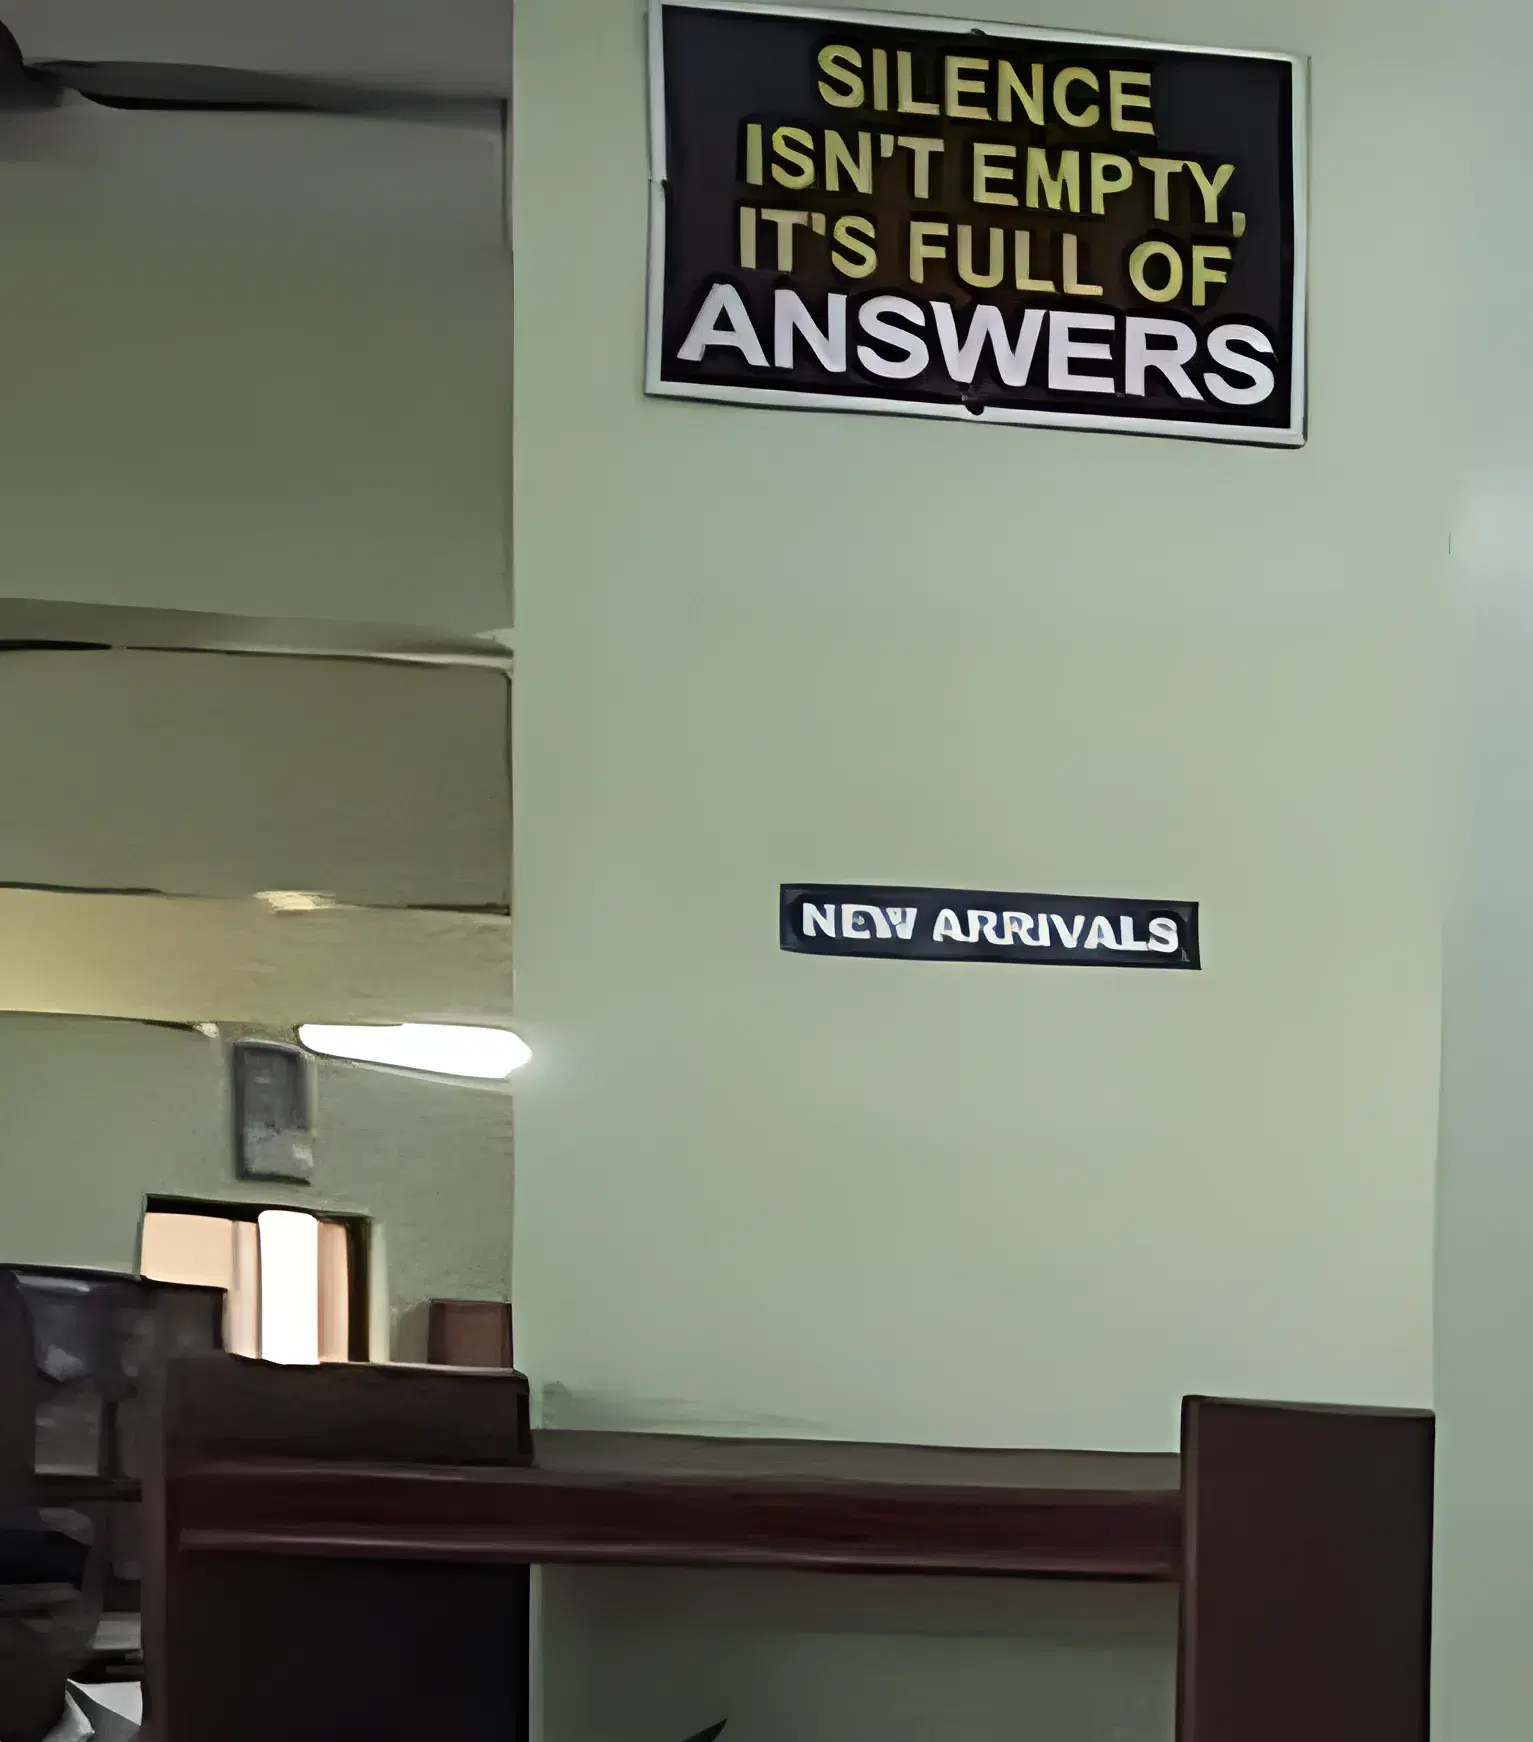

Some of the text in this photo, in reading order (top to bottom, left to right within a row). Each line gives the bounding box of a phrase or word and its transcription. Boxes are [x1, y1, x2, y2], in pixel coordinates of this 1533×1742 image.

[817, 44, 1155, 135] SILENCE
[745, 122, 1246, 237] ISN'T EMPTY,
[739, 207, 1231, 306] IT'S FULL OF
[676, 284, 1275, 406] ANSWERS
[802, 902, 1179, 953] NEW ARRIVALS
